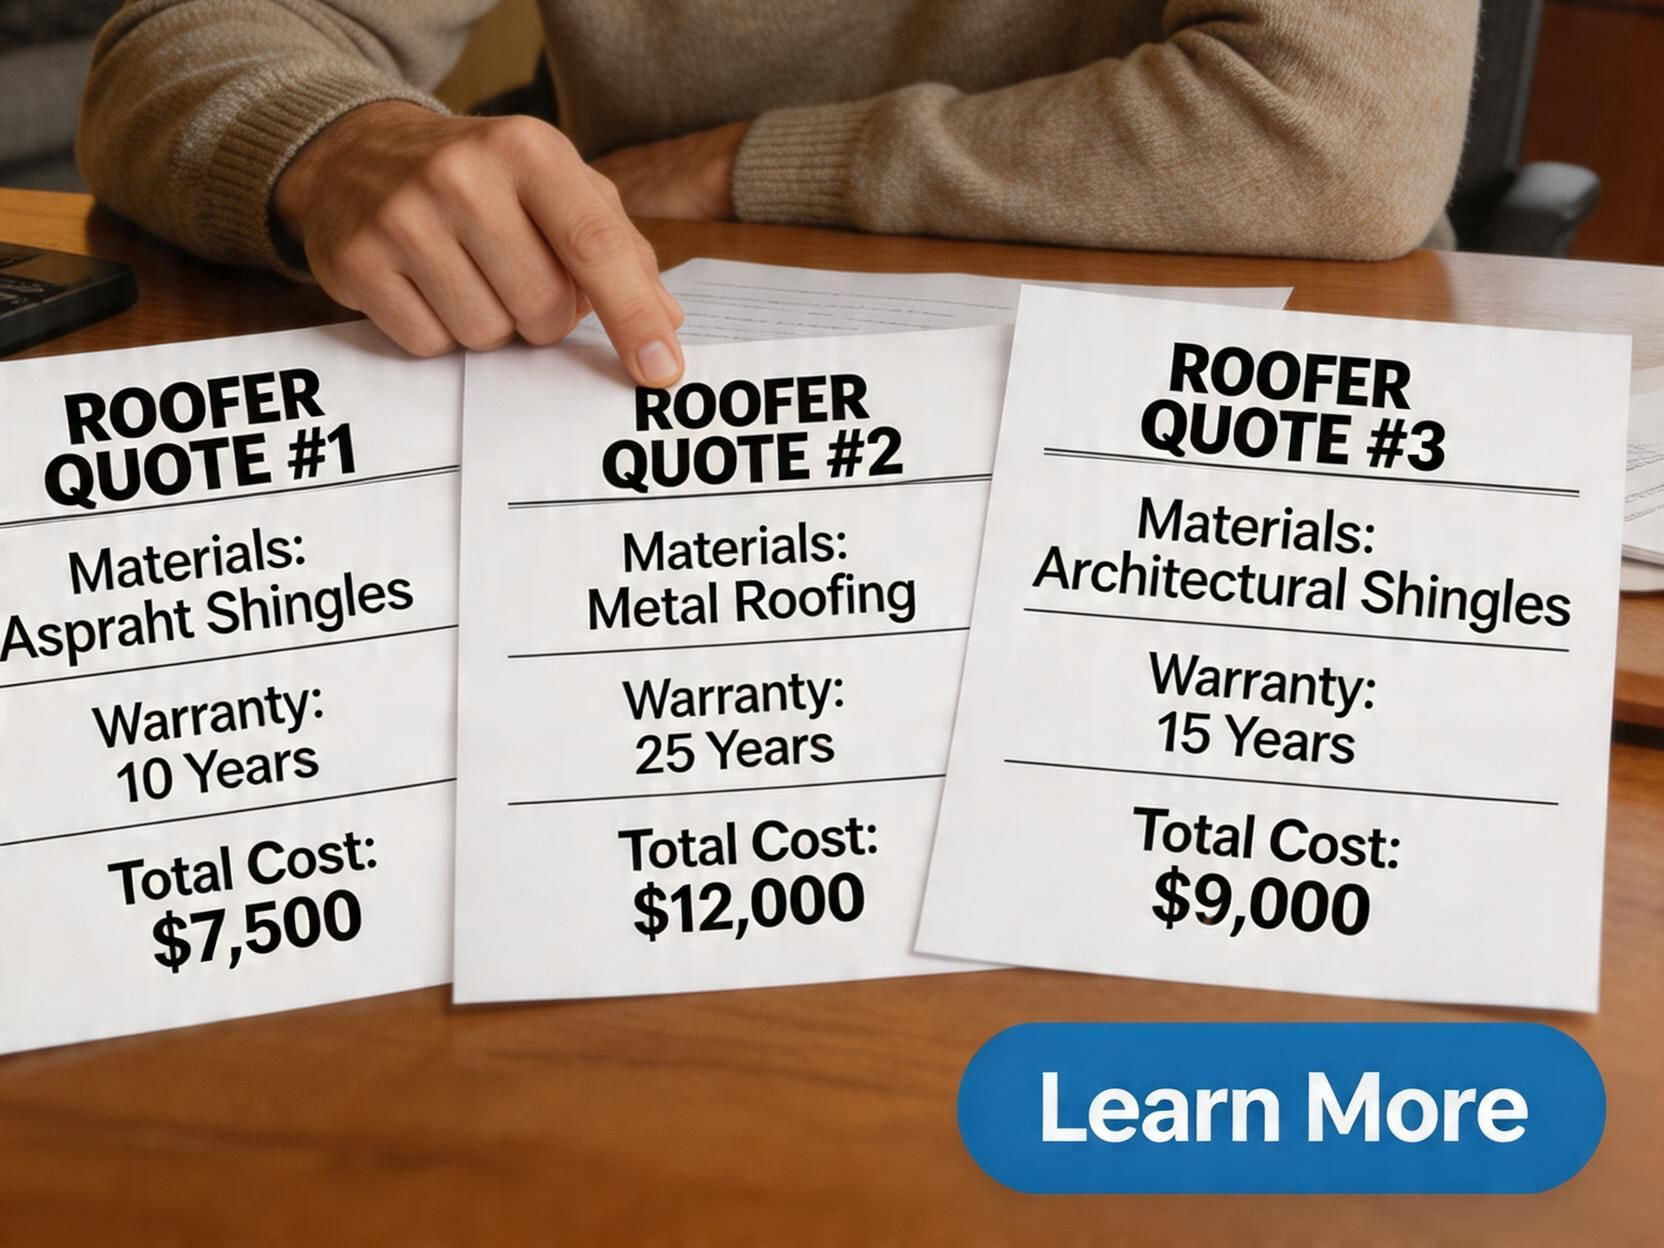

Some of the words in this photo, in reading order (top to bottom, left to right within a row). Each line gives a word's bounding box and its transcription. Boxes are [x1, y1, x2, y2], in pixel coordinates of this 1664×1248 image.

[64, 369, 325, 444] ROOFER
[634, 374, 869, 432] ROOFER
[1170, 343, 1410, 409] ROOFER
[44, 433, 271, 509] QUOTE
[287, 423, 356, 479] #1
[602, 432, 809, 493] QUOTE
[826, 427, 903, 478] #2
[1142, 399, 1351, 464] QUOTE
[1367, 418, 1446, 471] #3
[623, 522, 847, 572] Materials:
[1139, 497, 1374, 556] Materials:
[69, 528, 304, 594] Materials:
[1032, 546, 1347, 610] Architectural
[1361, 570, 1571, 633] Shingles
[0, 600, 194, 666] Aspraht
[207, 572, 413, 635] Shingles
[588, 582, 718, 629] Metal
[735, 572, 916, 623] Roofing
[92, 685, 323, 748] Warranty:
[622, 674, 844, 719] Warranty:
[1149, 652, 1376, 718] Warranty:
[635, 732, 694, 775] 25
[706, 729, 835, 769] Years
[1158, 711, 1210, 753] 15
[1224, 715, 1355, 764] Years
[117, 757, 173, 803] 10
[182, 747, 319, 793] Years
[107, 846, 233, 904] Total
[247, 831, 378, 884] Cost:
[617, 821, 737, 870] Total
[752, 817, 878, 861] Cost:
[1133, 807, 1256, 858] Total
[1270, 819, 1401, 870] Cost:
[152, 890, 362, 974] $7,500
[633, 873, 865, 941] $12,000
[1151, 864, 1370, 939] $9,000
